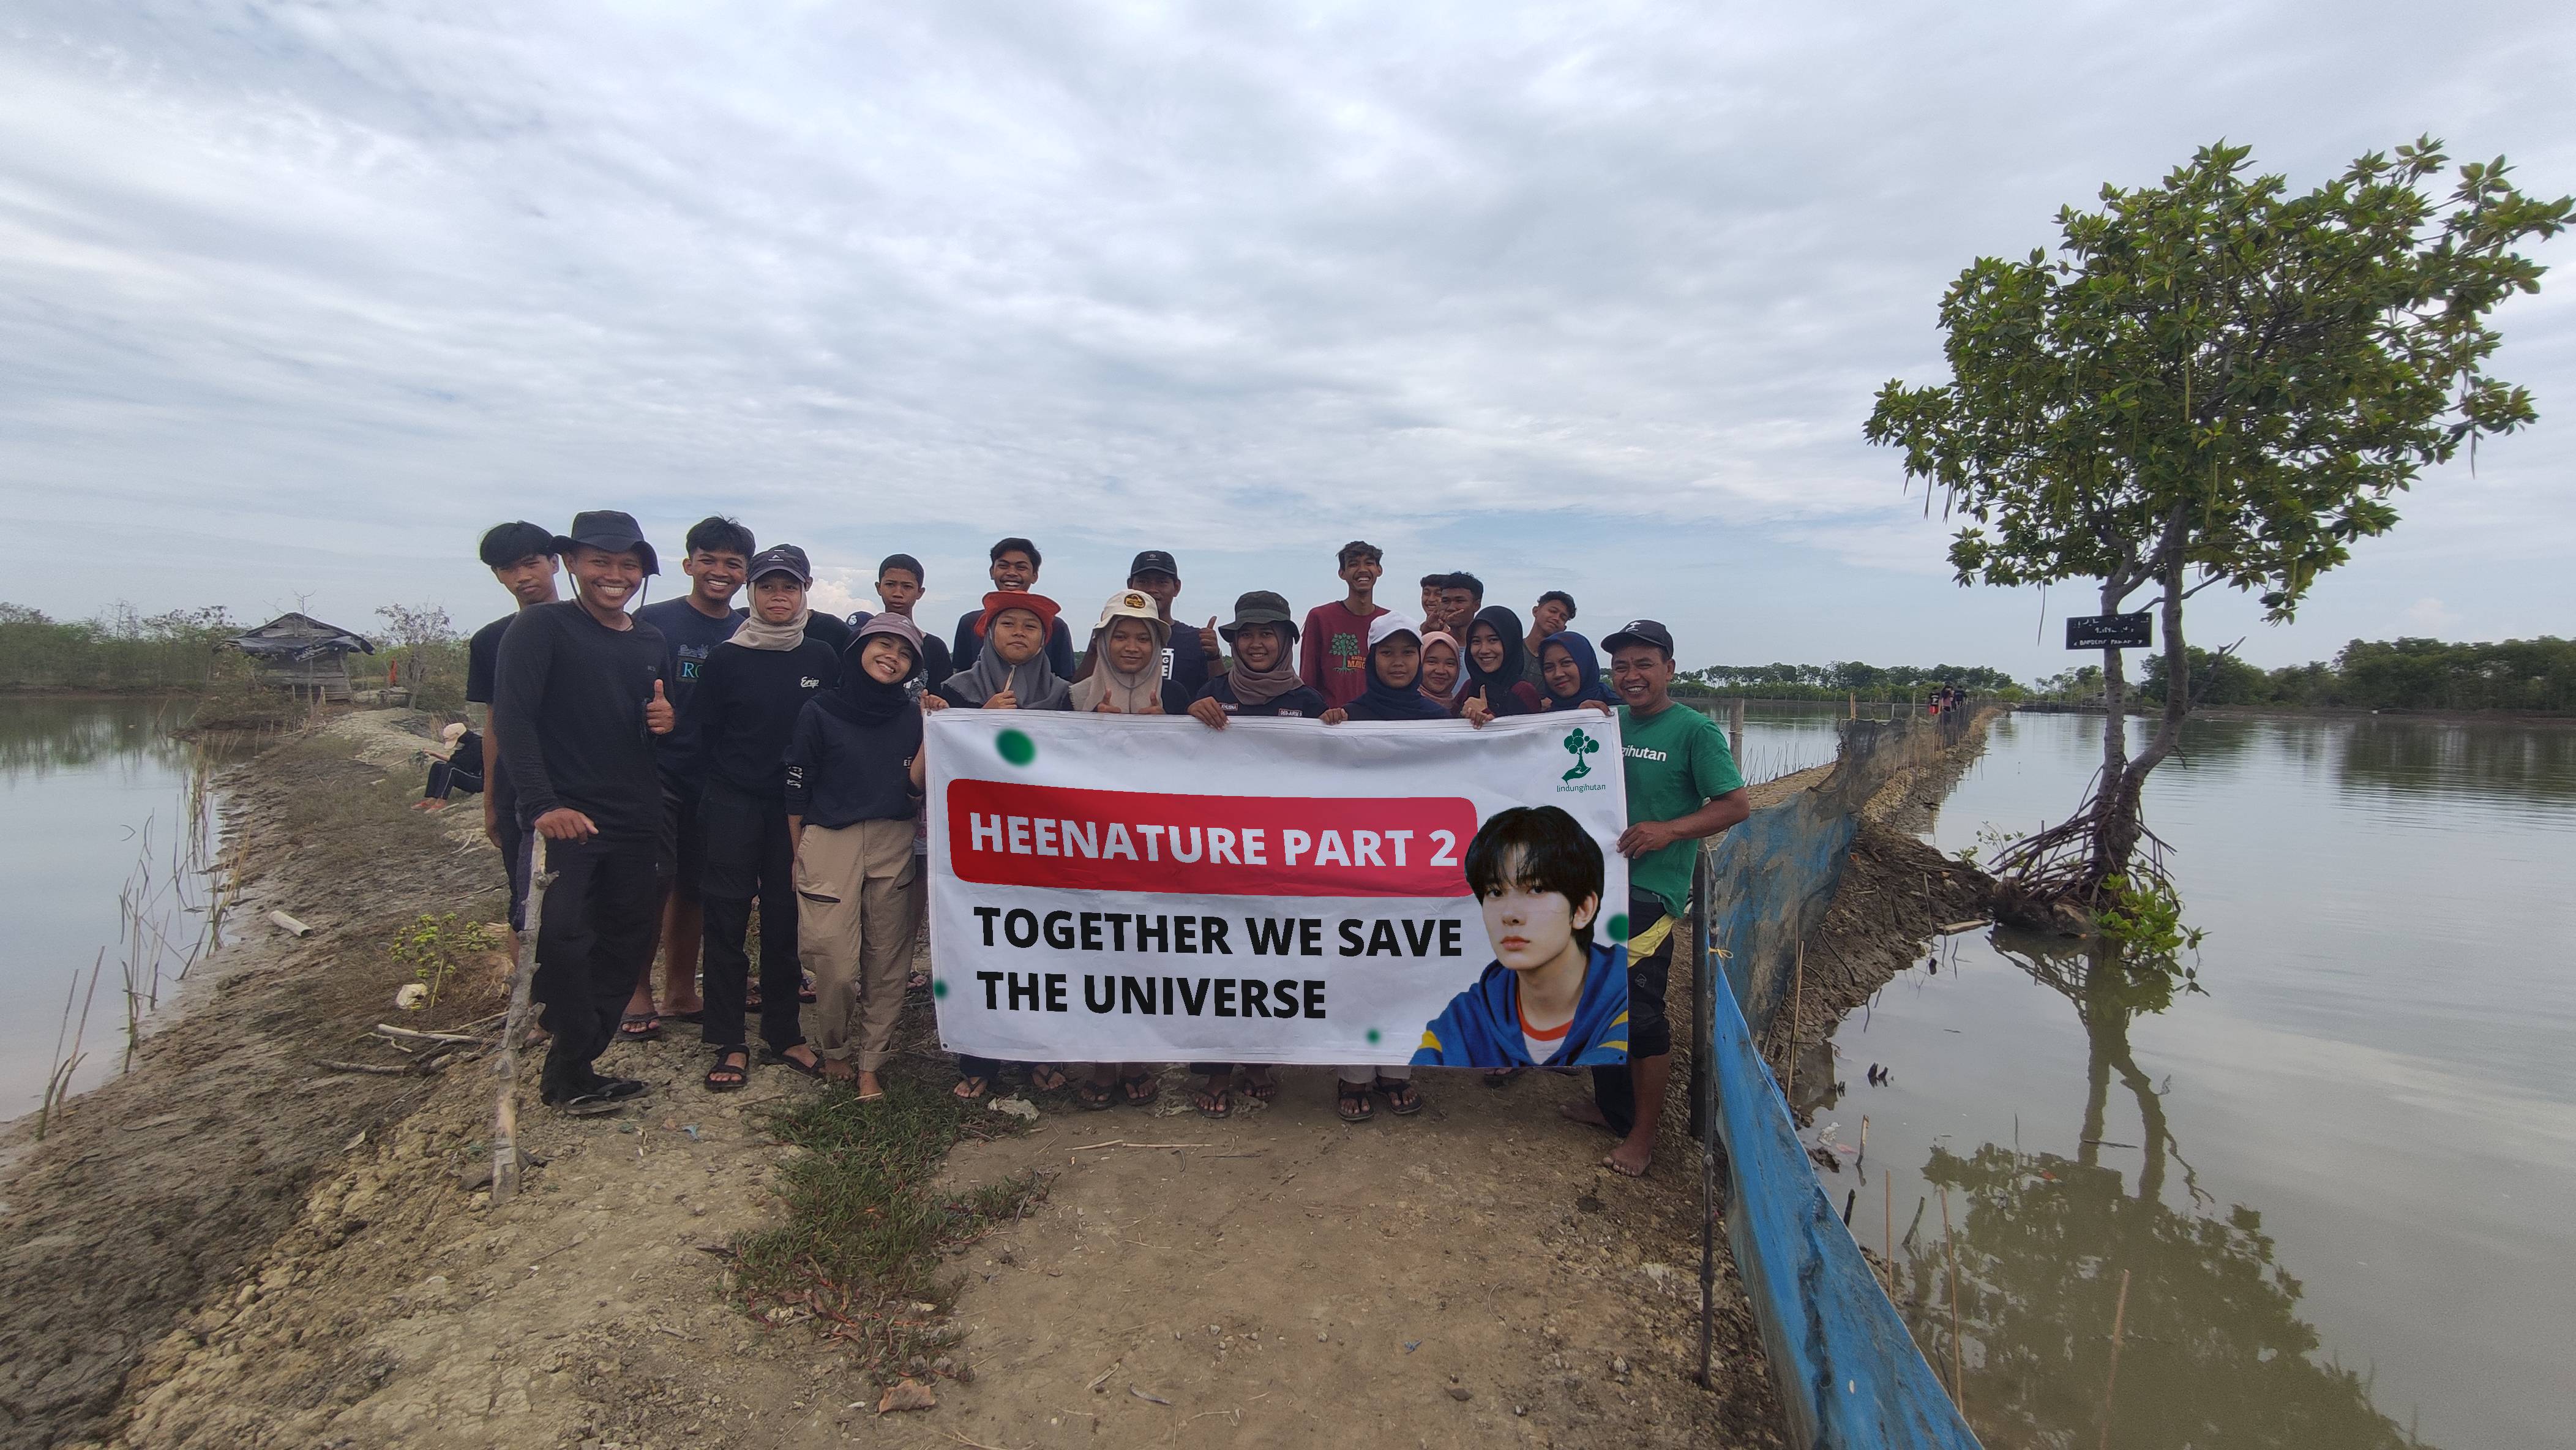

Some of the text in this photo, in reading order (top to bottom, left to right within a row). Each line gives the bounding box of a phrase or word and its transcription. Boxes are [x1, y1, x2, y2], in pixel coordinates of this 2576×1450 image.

[1557, 784, 1606, 793] lindungihutan
[970, 812, 1458, 866] HEENATURE PART 2
[973, 906, 1462, 957] TOGETHER WE SAVE
[976, 971, 1326, 1019] THE UNIVERSE
